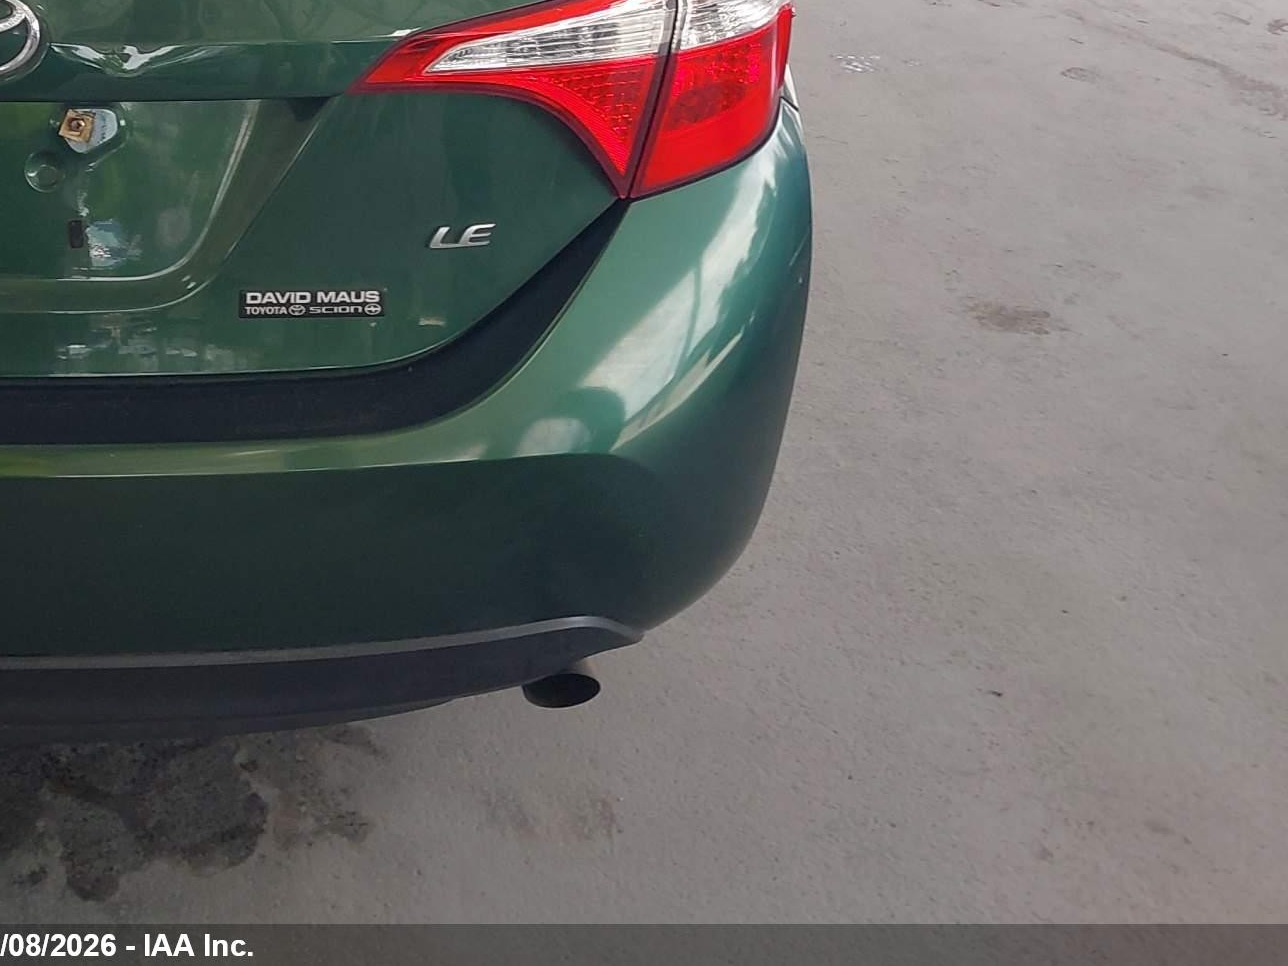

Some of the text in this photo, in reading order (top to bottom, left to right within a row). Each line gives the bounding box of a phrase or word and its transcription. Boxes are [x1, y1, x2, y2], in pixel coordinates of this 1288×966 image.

[429, 223, 497, 249] LE
[245, 290, 380, 304] DAVID MAUS
[244, 306, 288, 315] TOYOTA
